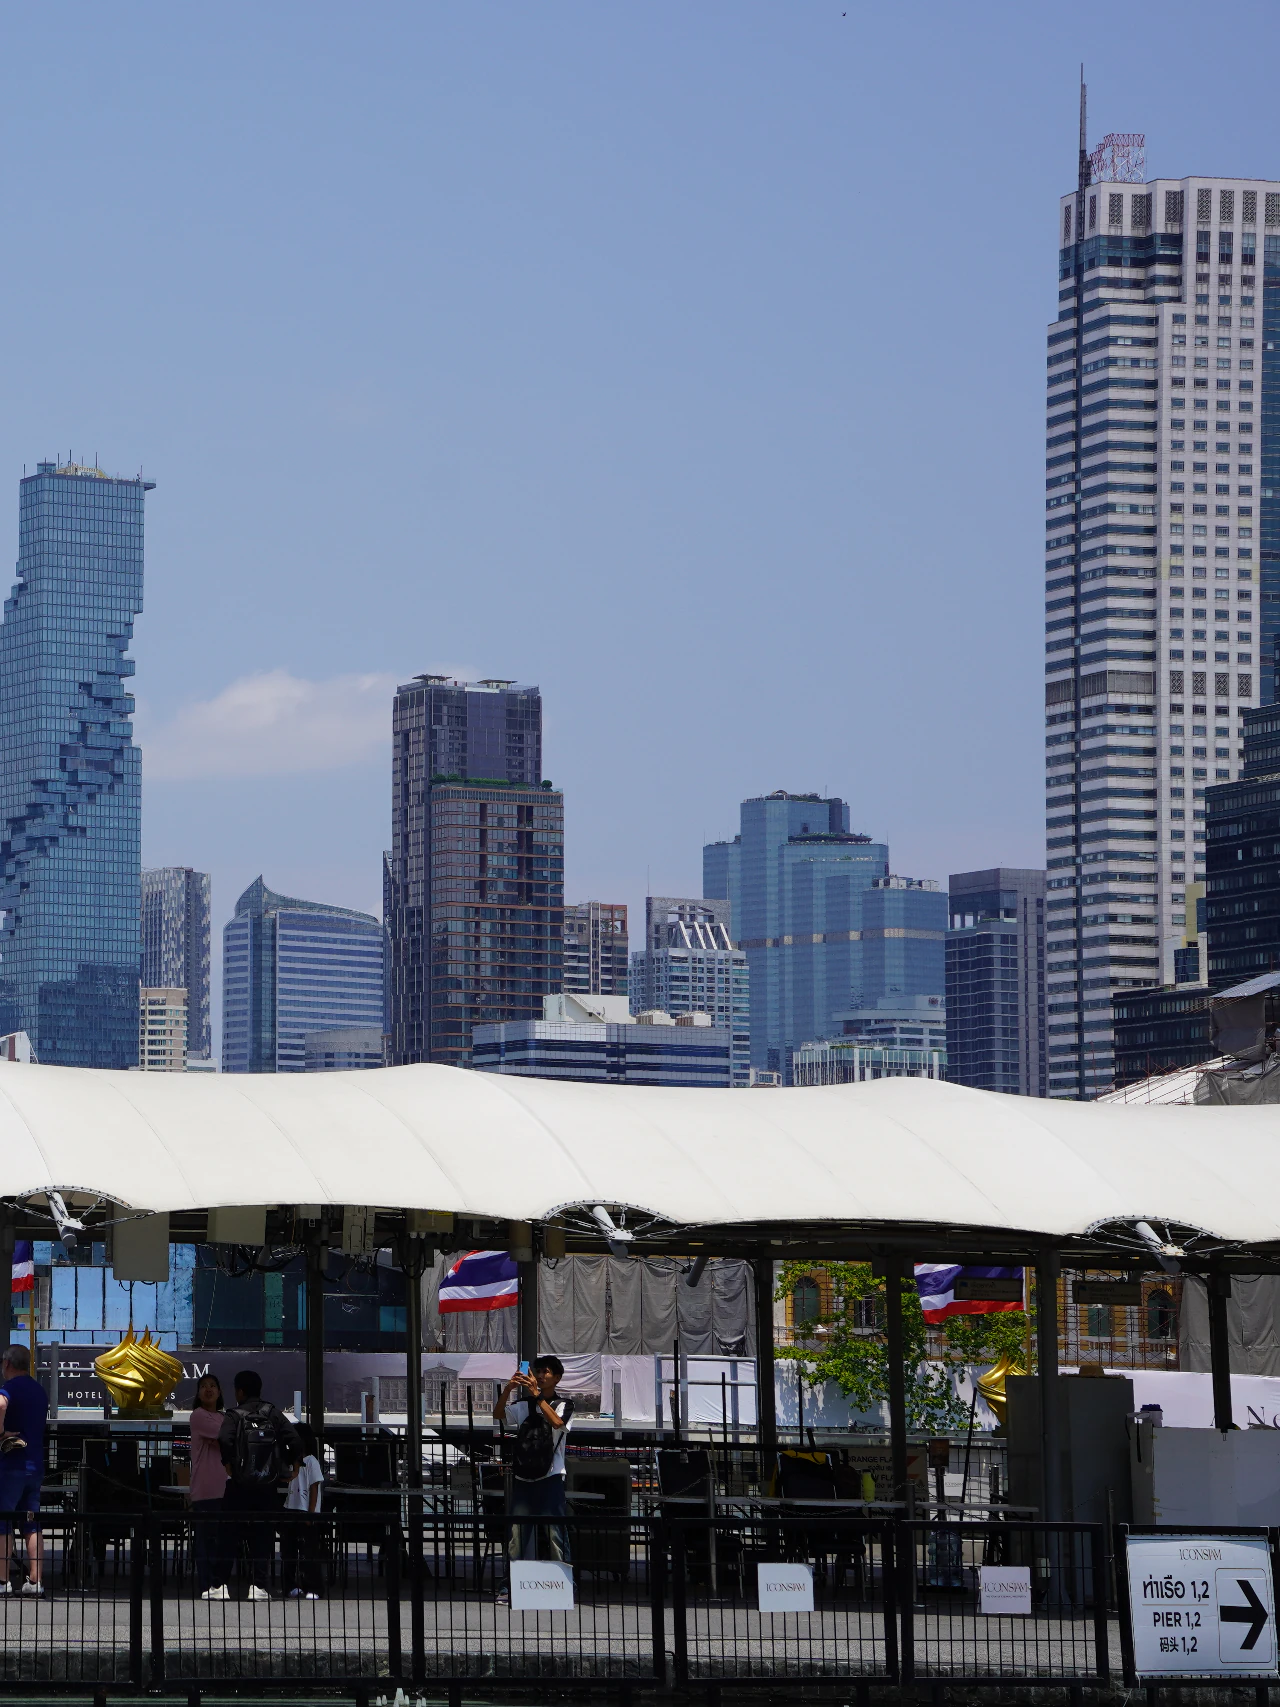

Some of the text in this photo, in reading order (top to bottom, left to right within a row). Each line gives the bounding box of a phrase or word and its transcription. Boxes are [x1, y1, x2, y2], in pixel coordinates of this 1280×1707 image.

[879, 1455, 893, 1463] FLA
[1178, 1548, 1223, 1561] ICONSIAM
[519, 1580, 564, 1590] ICONSIAM
[765, 1582, 806, 1592] ICONSIAM
[983, 1581, 1028, 1593] ICONSIAM
[1142, 1574, 1210, 1602] ท่าเรือ 1,2
[1153, 1611, 1202, 1630] PIER 1,2
[1159, 1636, 1198, 1656] 码头 1,2
